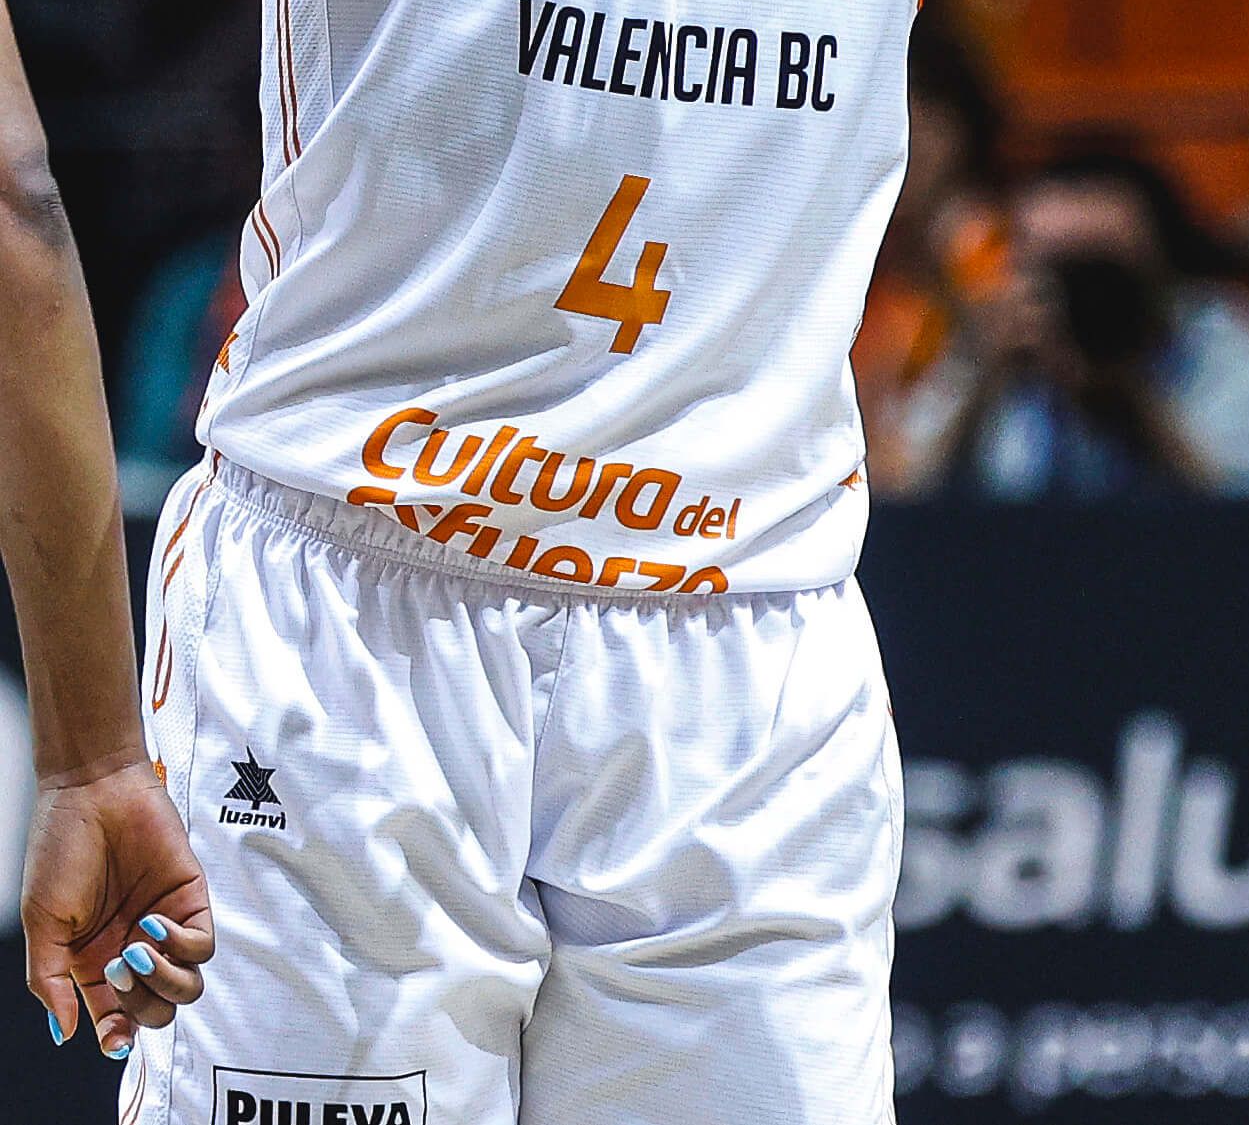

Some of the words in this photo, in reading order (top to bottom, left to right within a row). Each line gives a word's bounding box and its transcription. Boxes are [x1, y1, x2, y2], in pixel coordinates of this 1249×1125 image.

[776, 31, 838, 112] BC
[553, 173, 672, 355] 4
[361, 407, 682, 531] Cultura
[673, 494, 742, 540] del
[218, 805, 287, 830] luanvi
